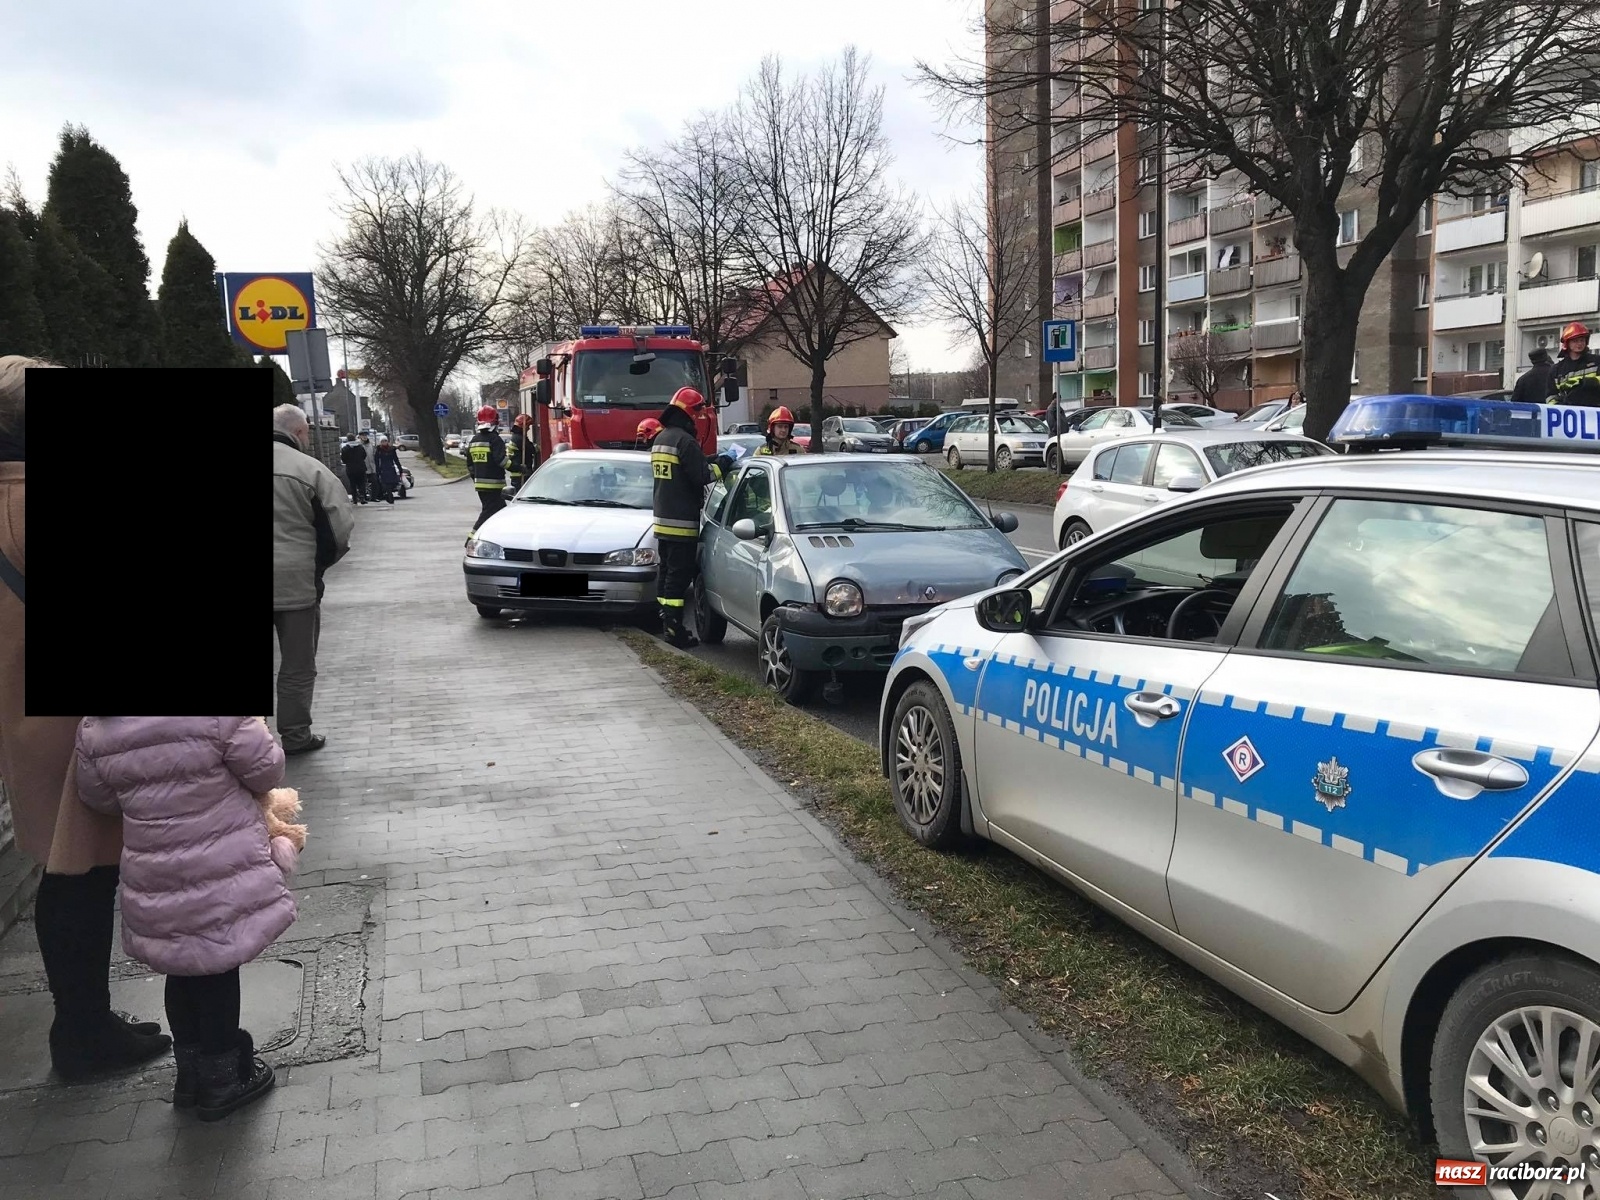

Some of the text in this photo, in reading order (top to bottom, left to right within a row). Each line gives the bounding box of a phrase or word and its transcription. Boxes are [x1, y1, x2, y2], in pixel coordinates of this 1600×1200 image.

[1547, 407, 1600, 440] POLI
[1022, 678, 1118, 749] POLICJA
[1238, 751, 1247, 767] R
[1324, 785, 1338, 795] 112
